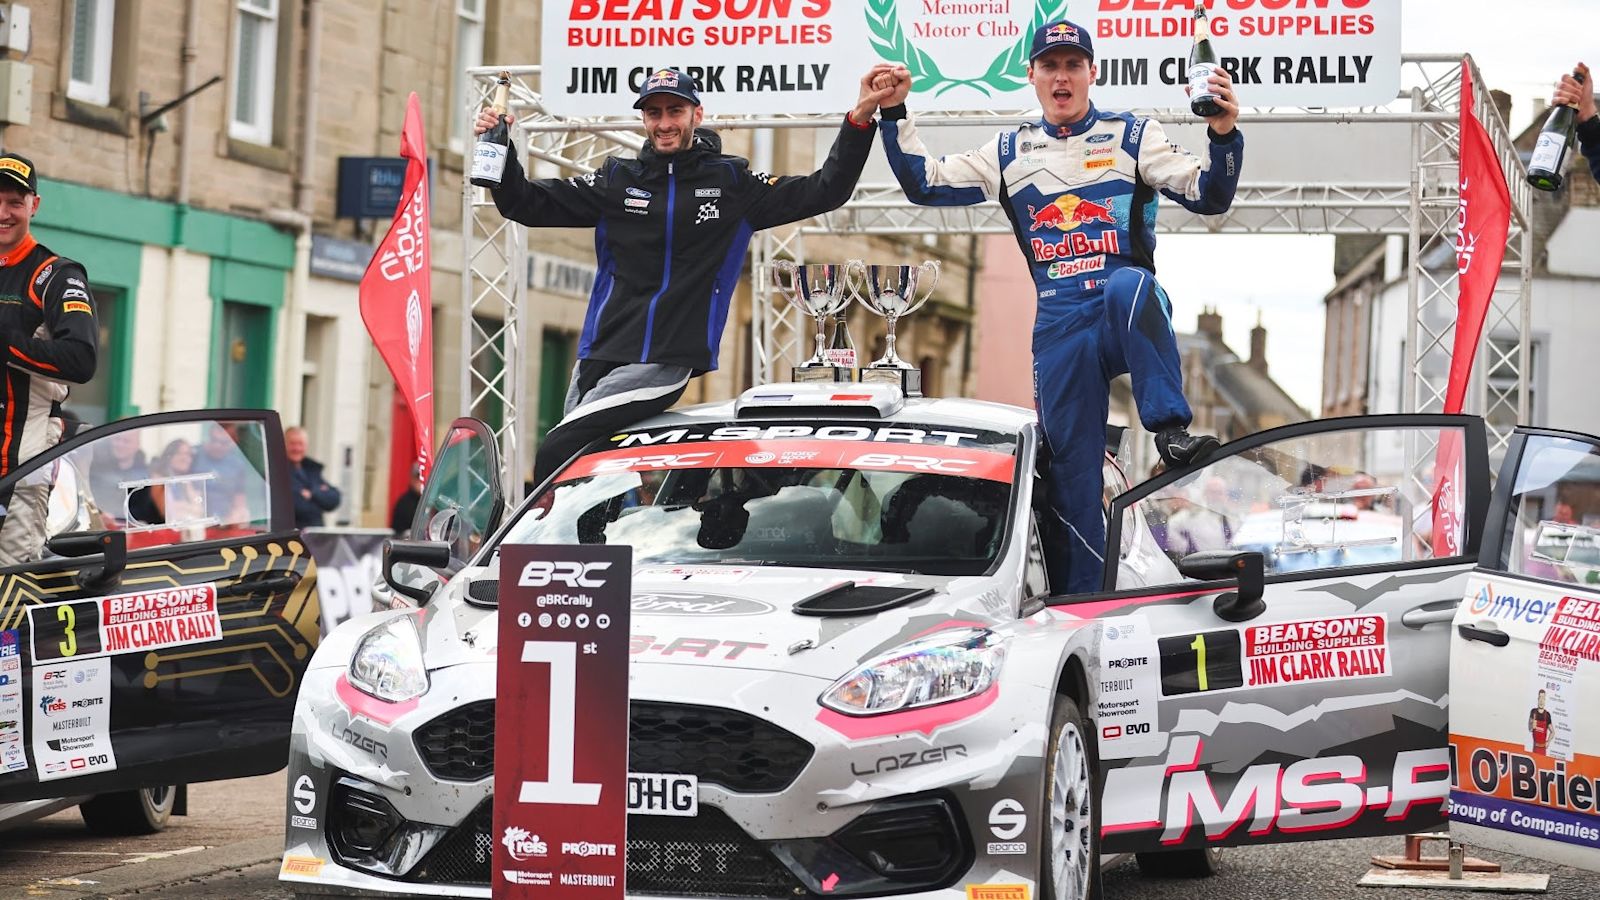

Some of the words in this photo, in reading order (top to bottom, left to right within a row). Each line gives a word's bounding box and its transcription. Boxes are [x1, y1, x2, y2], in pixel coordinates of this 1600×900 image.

[569, 0, 832, 21] BEATSONS
[922, 0, 1010, 15] Memorial
[913, 21, 970, 38] Motor
[976, 20, 1019, 37] Club
[1239, 15, 1374, 36] SUPPLIES
[568, 27, 695, 47] BUILDING
[704, 24, 832, 45] SUPPLIES
[567, 67, 617, 94] JIM
[745, 64, 830, 91] RALLY
[1097, 58, 1148, 86] JIM
[1159, 57, 1261, 85] CLRK
[1273, 55, 1373, 84] RALLY
[1031, 233, 1073, 262] Red
[1071, 230, 1120, 256] Bull
[1059, 256, 1103, 276] Castrol
[617, 426, 978, 448] M-SPORT
[590, 452, 717, 473] BRC
[849, 453, 979, 473] BRC
[517, 561, 613, 588] BRC
[110, 587, 208, 615] BEATSON'S
[536, 594, 593, 608] @BRCrally
[109, 611, 158, 625] BUILDING
[160, 602, 208, 618] SUPPLIES
[56, 604, 78, 657] 3
[106, 625, 130, 652] JIM
[131, 619, 175, 649] CLARK
[179, 613, 217, 641] RALLY
[1254, 617, 1377, 645] BEATSON'S
[1253, 642, 1314, 656] BUILDING
[1316, 634, 1377, 650] SUPPLIES
[1108, 656, 1148, 669] PROBITE
[1190, 634, 1209, 691] 1
[1248, 656, 1280, 686] JIM
[1279, 652, 1336, 684] CLARK
[1338, 648, 1386, 678] RALLY
[1538, 650, 1579, 666] BEATSON'S
[1100, 679, 1134, 693] TERBUILT
[49, 698, 66, 711] reis
[72, 697, 104, 709] PROBITE
[52, 716, 91, 731] MASTERBUILT
[1125, 723, 1151, 735] evo
[61, 734, 95, 745] Motorsport
[62, 742, 94, 752] Showroom
[331, 723, 388, 760] LAZER
[88, 754, 108, 766] evo
[850, 743, 969, 777] LAZER
[293, 817, 317, 829] sparco
[1490, 808, 1507, 824] of
[1510, 810, 1600, 841] Companies
[516, 835, 548, 854] reis
[561, 841, 617, 857] PROBITE
[988, 843, 1026, 854] sparco
[285, 859, 320, 872] PIRELLI
[517, 870, 553, 880] Motorsport
[517, 877, 551, 886] Showroom
[560, 873, 616, 887] MASTERBUILT
[971, 887, 1025, 900] PIRELLI
